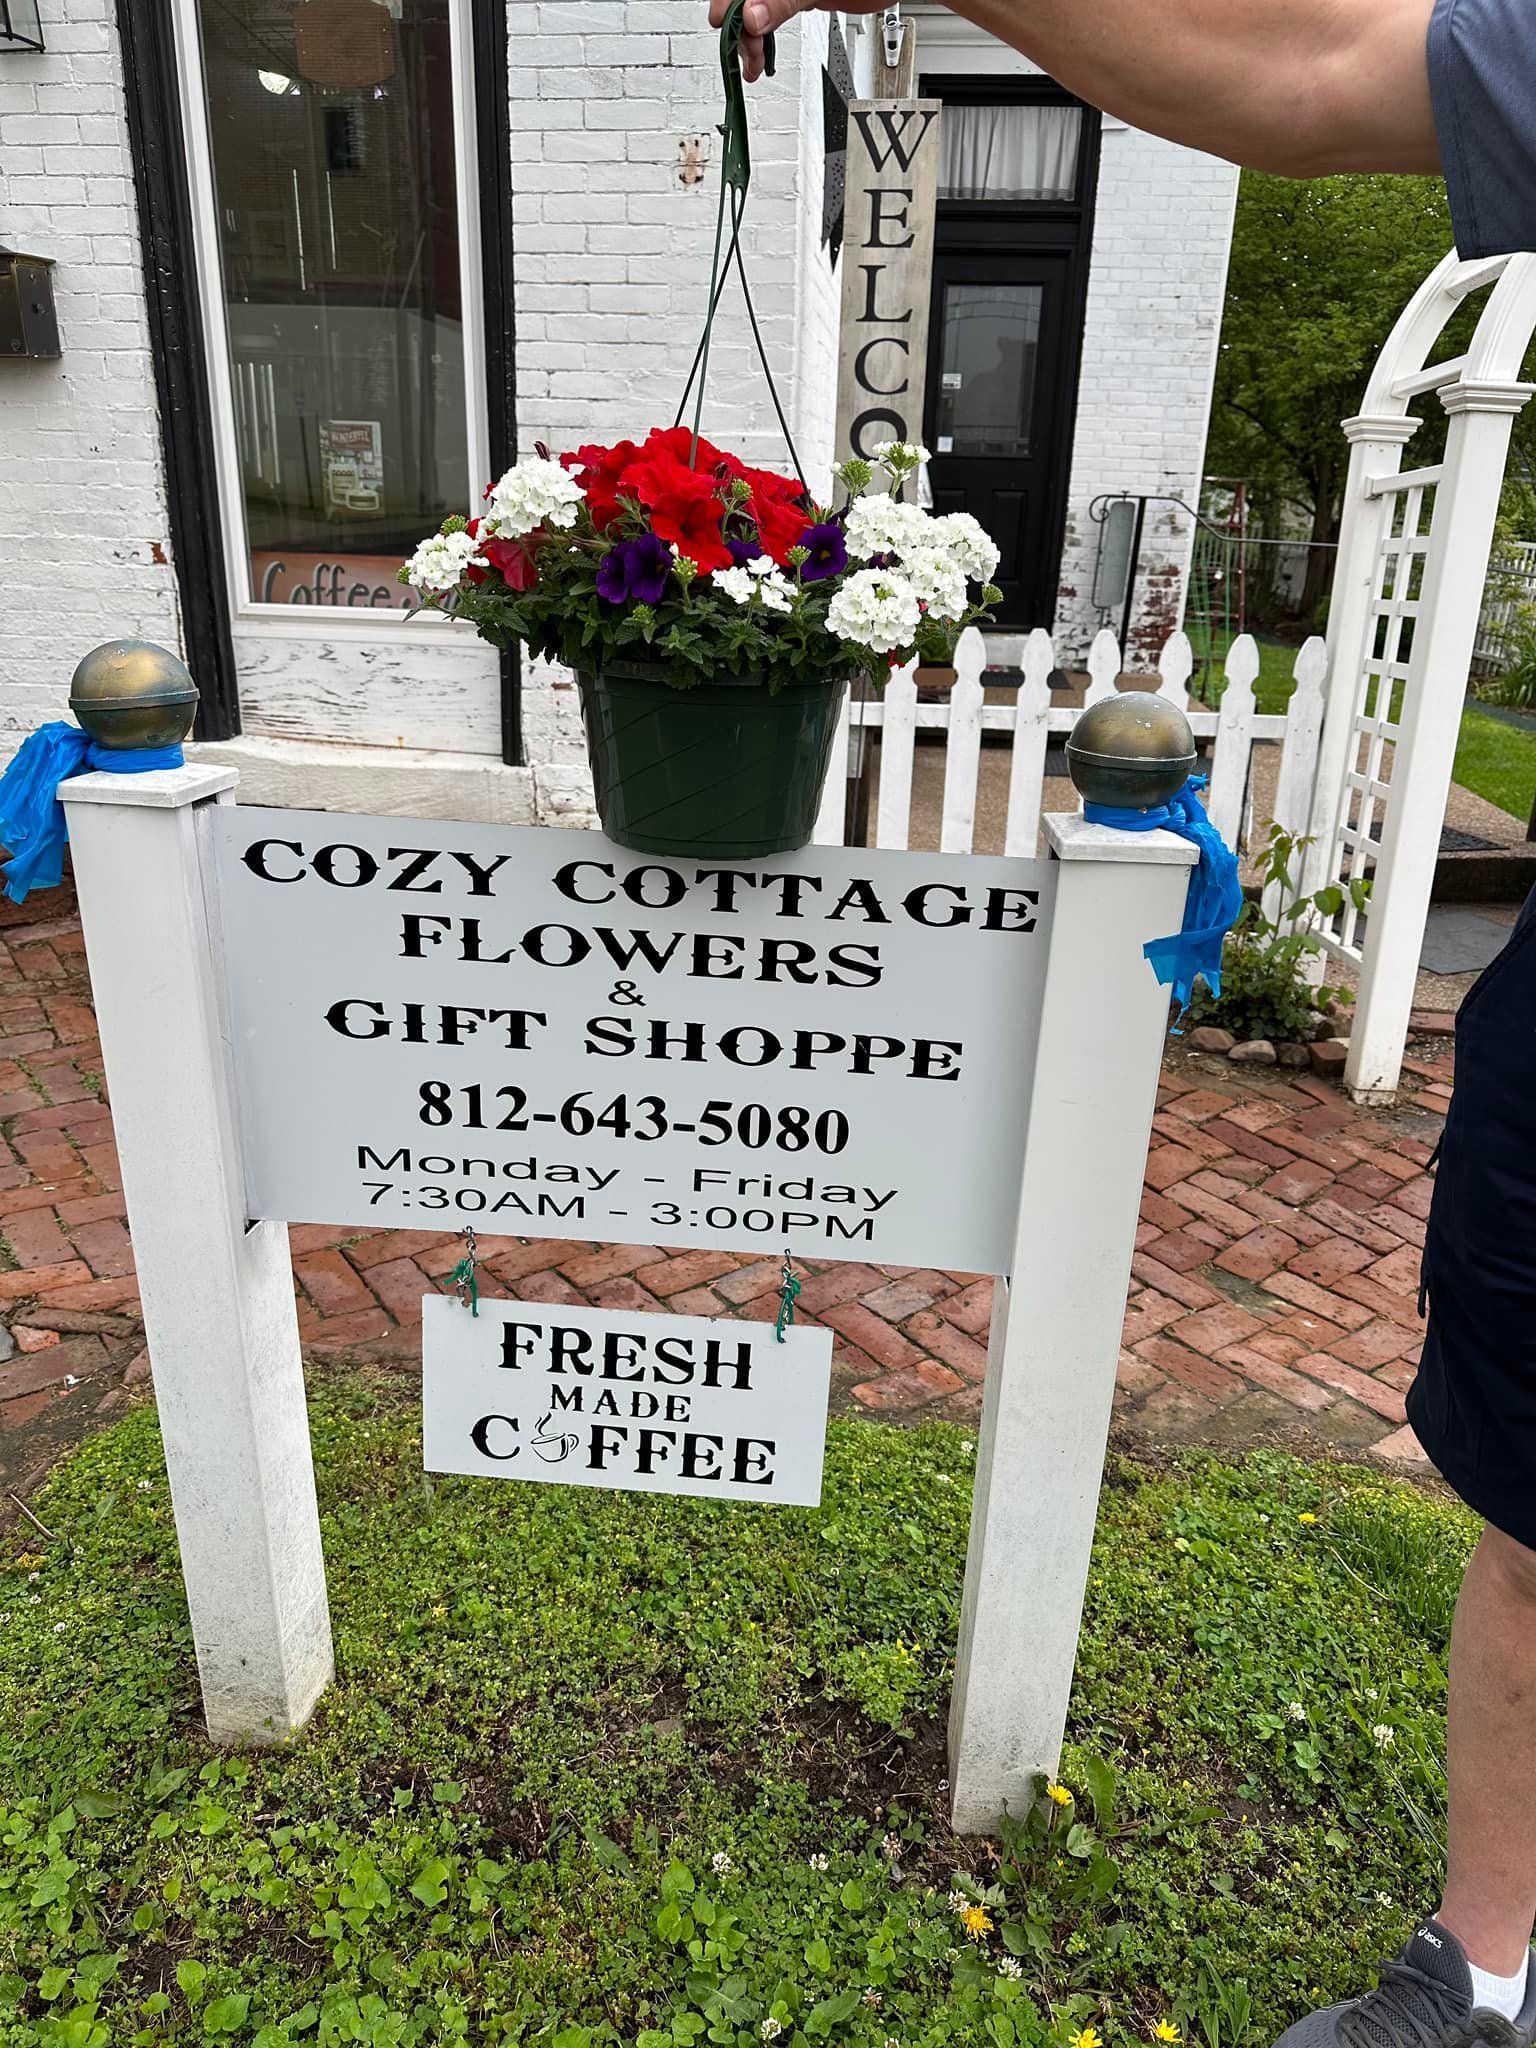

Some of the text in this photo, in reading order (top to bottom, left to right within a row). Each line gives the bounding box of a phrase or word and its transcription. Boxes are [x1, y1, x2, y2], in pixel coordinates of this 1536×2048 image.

[239, 838, 1041, 933] COZY COTTAGE
[398, 913, 885, 988] FLOWERS
[607, 980, 647, 1007] &
[323, 999, 964, 1082] GIFT SHOPPE
[418, 1080, 850, 1155] 812-643-5080
[357, 1145, 621, 1191] Monday
[693, 1168, 899, 1212] Friday
[361, 1182, 585, 1219] 7:30AM
[650, 1202, 875, 1241] 3:00PM
[498, 1321, 753, 1391] FRESH
[548, 1383, 692, 1423] MADE
